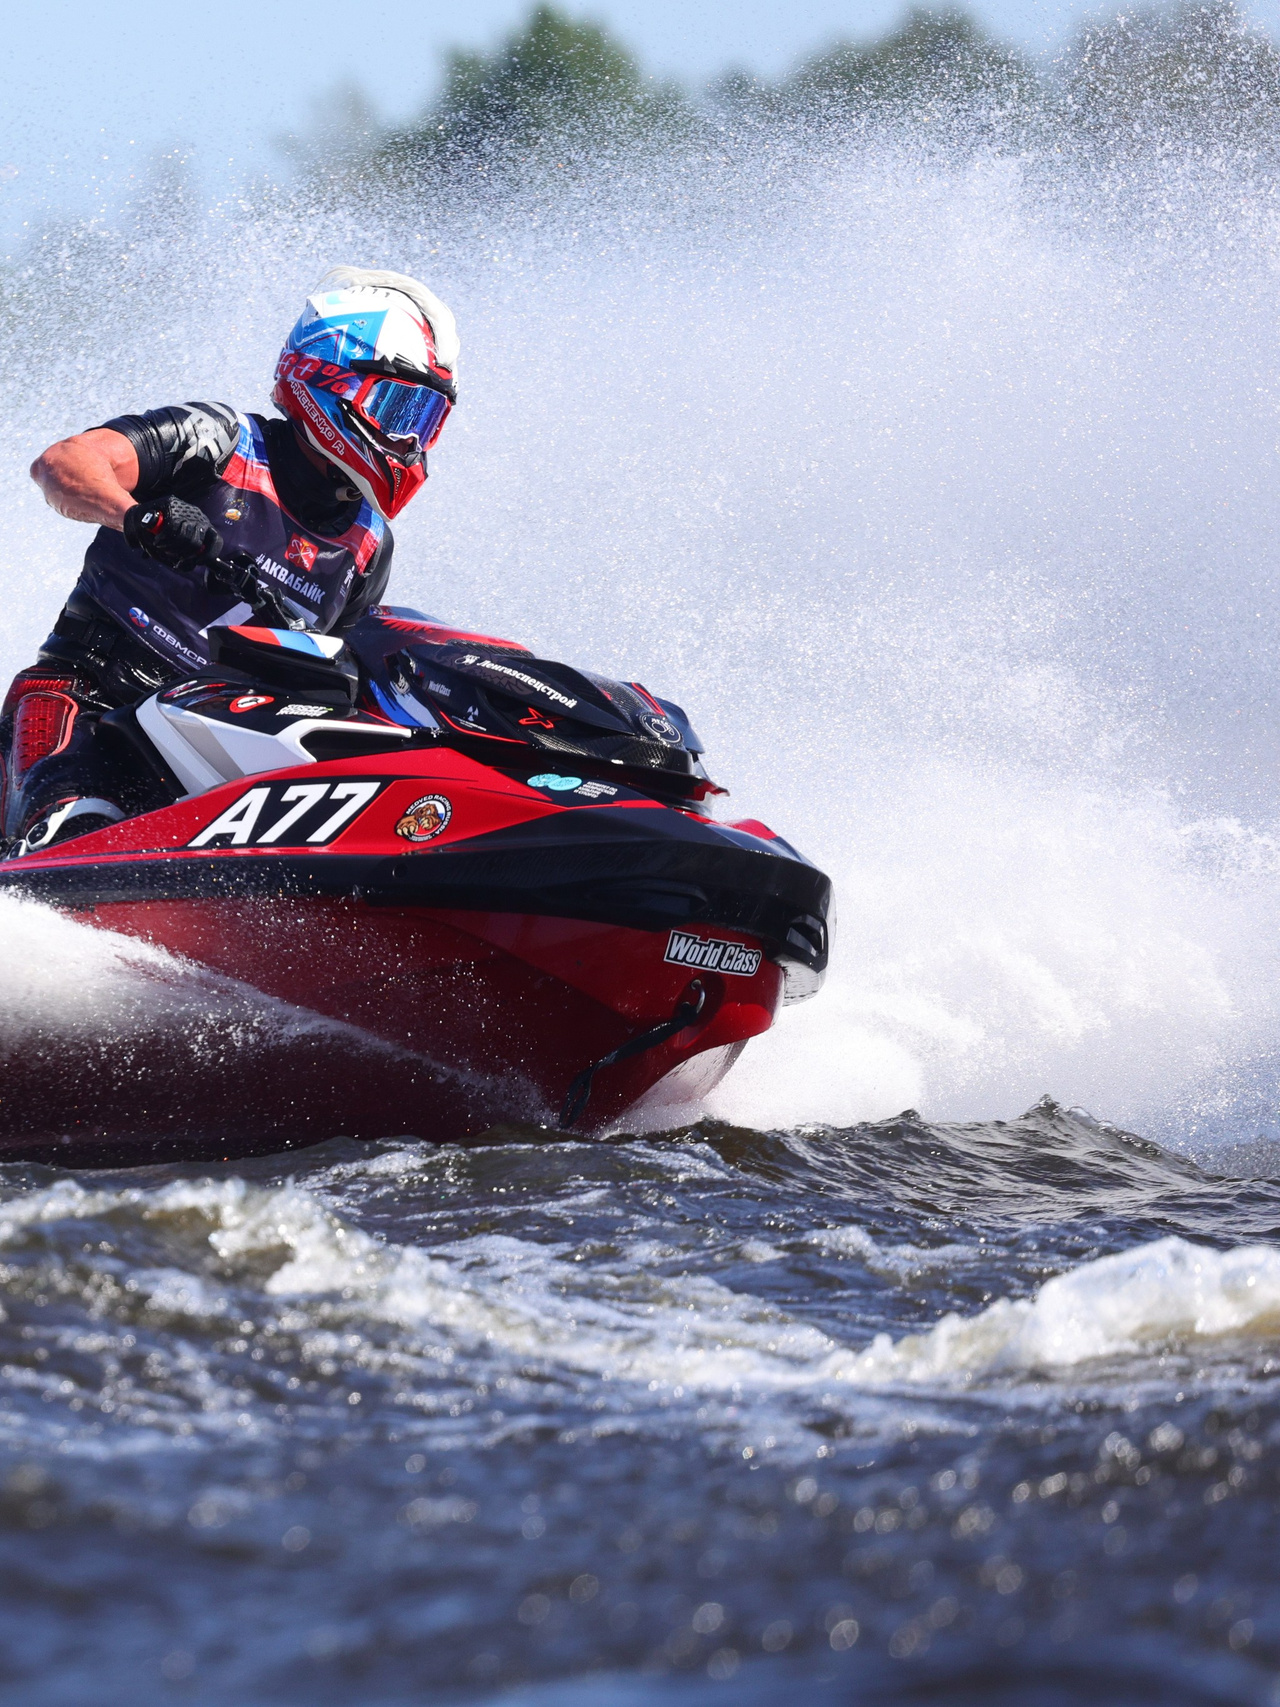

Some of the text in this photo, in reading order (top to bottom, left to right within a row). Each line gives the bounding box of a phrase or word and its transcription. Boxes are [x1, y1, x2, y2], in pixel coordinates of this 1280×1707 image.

[287, 379, 335, 441] ANCHENKO
[255, 553, 327, 604] #АКВАБАЙК
[152, 625, 208, 666] ФВМСР
[476, 659, 578, 709] Ленгазспецстрой
[187, 782, 381, 847] A77
[405, 794, 452, 835] MEDVED RACING RUSSIA
[668, 934, 760, 972] World Class
